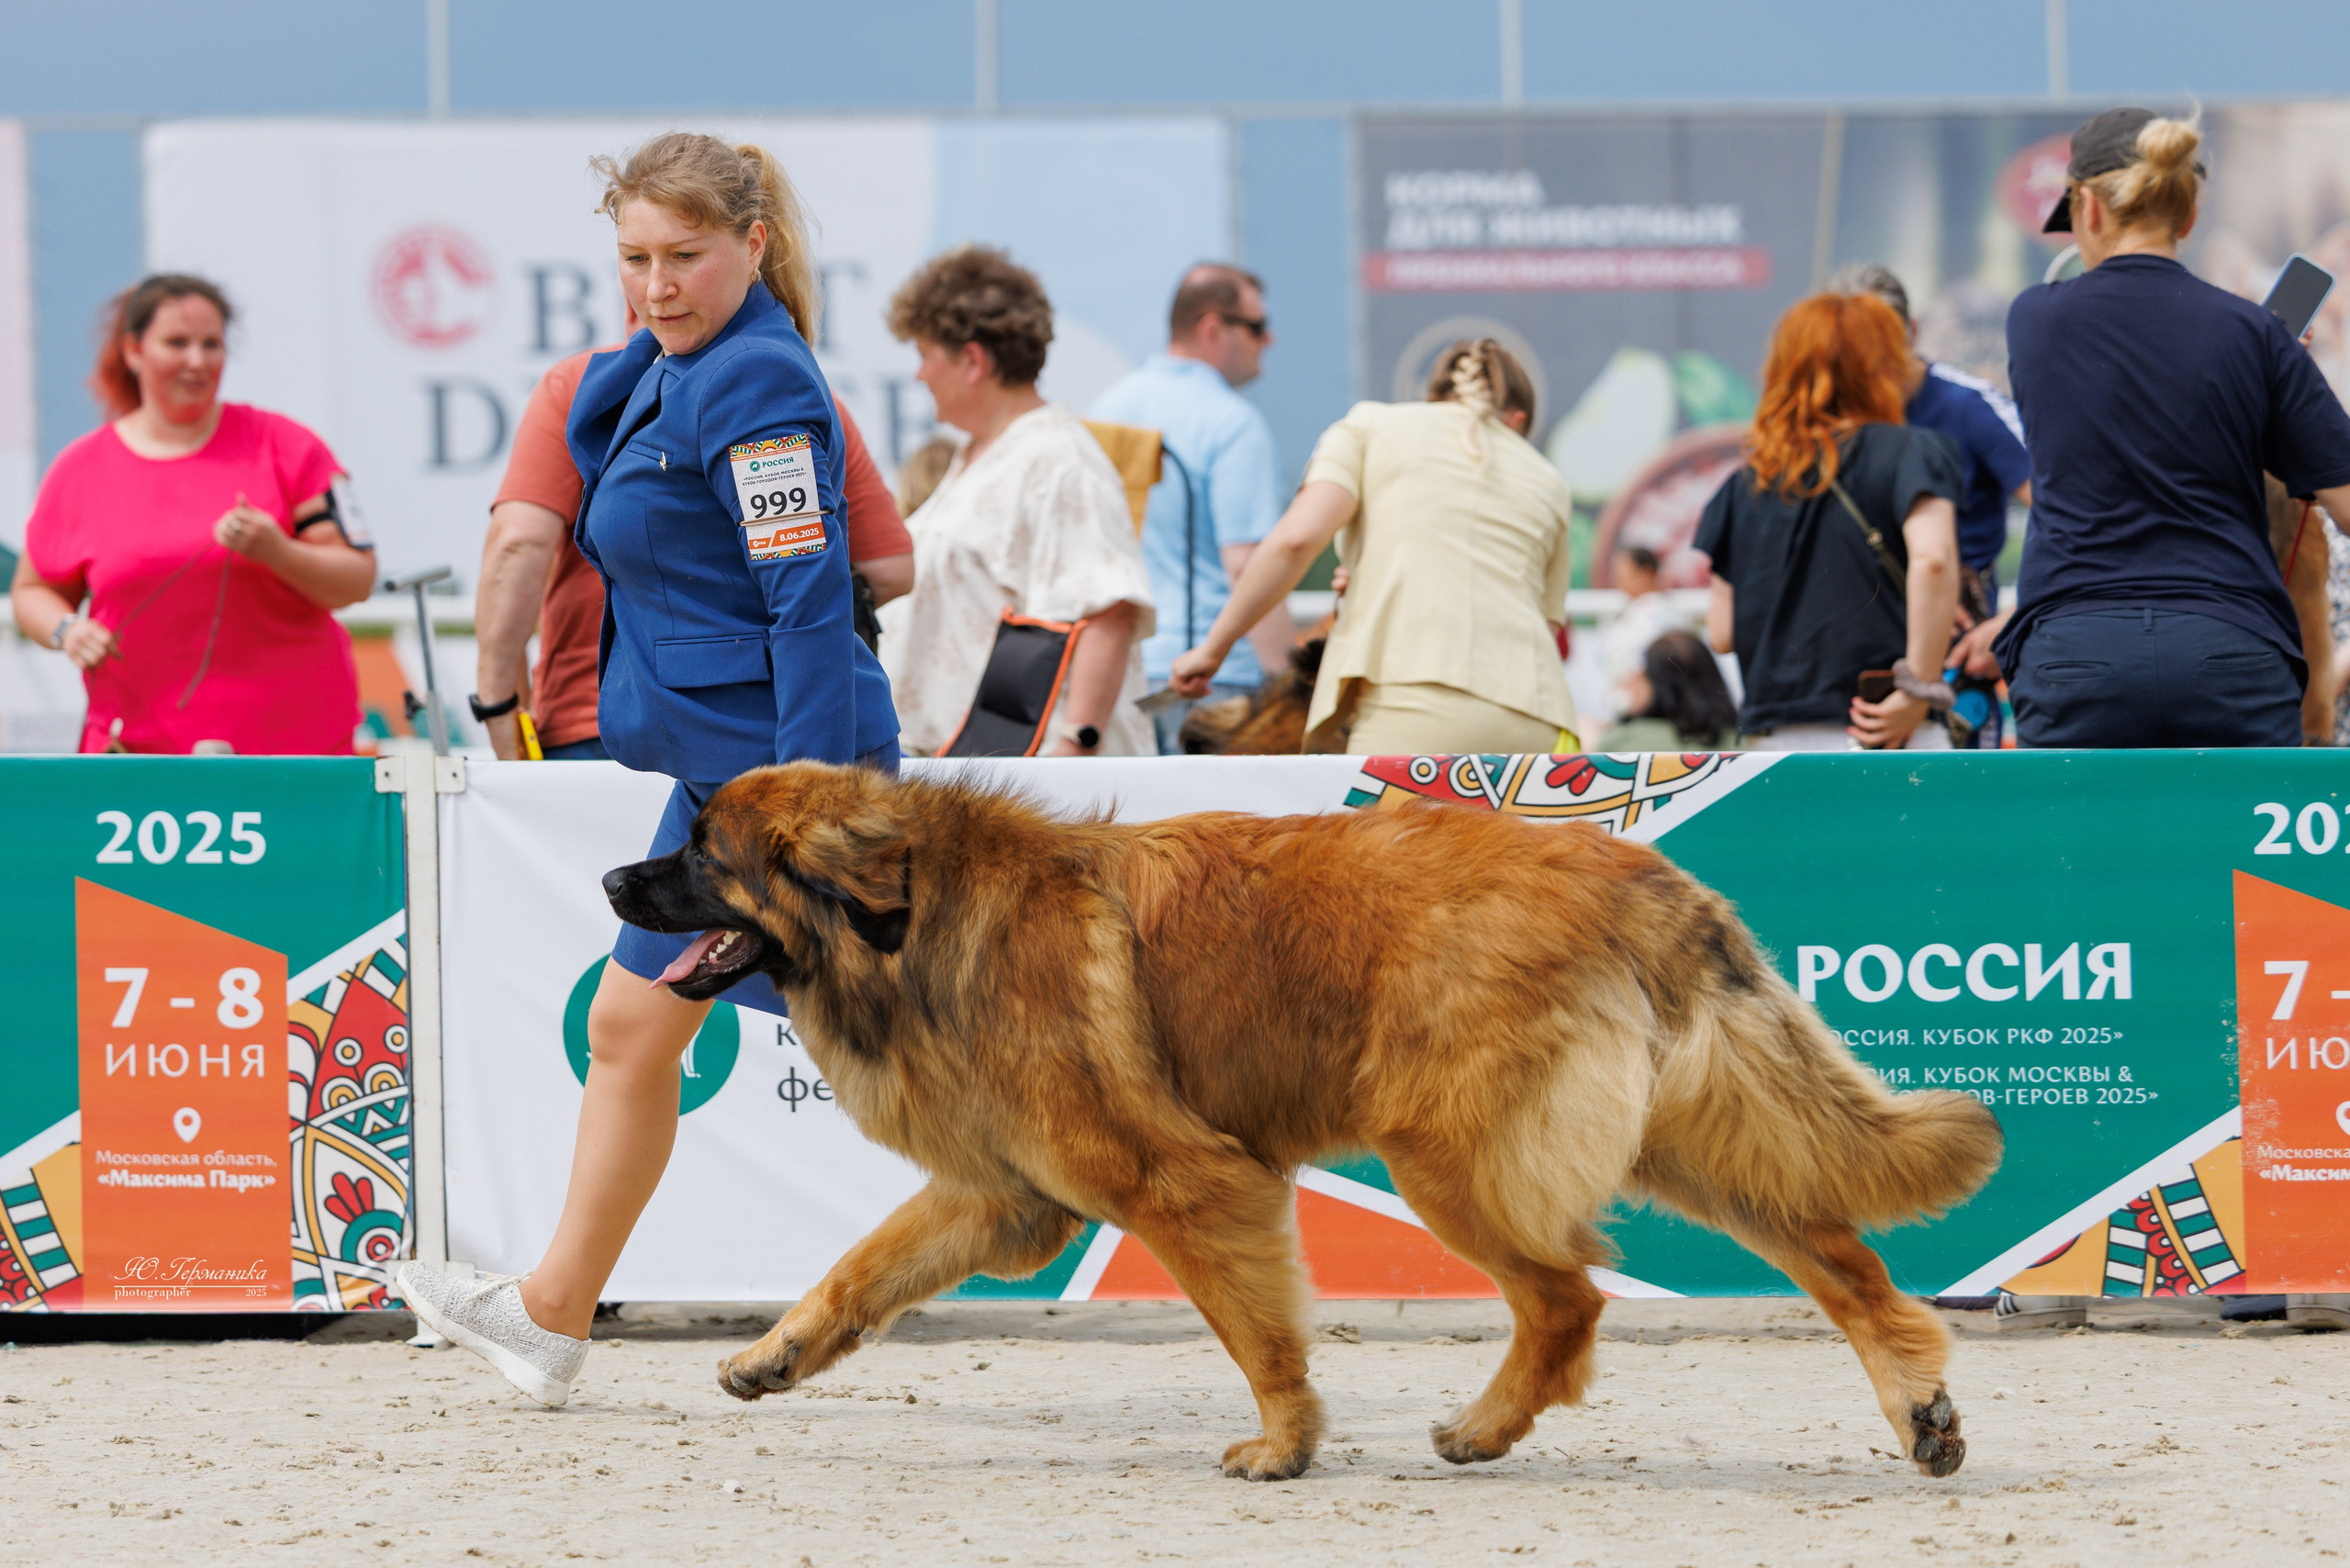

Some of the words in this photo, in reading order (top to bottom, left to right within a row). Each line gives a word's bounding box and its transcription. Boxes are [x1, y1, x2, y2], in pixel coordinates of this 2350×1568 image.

[762, 456, 794, 468] РОССИЯ
[750, 487, 807, 519] 999
[779, 527, 820, 542] 8.06.2025
[95, 810, 266, 865] 2025
[2253, 801, 2350, 856] 20
[1796, 942, 2132, 1003] РОССИЯ
[104, 967, 150, 1028] 7
[217, 967, 264, 1030] 8
[2264, 959, 2310, 1021] 7
[1829, 1029, 1916, 1047] ОССИЯ.
[1923, 1028, 1999, 1046] КУБОК
[2008, 1027, 2053, 1045] РКФ
[2062, 1026, 2123, 1045] 2025»
[106, 1043, 265, 1078] ИЮНЯ
[2266, 1036, 2350, 1070] ИЮ
[1924, 1067, 2000, 1084] КУБОК
[2009, 1066, 2110, 1083] МОСКВЫ
[2118, 1065, 2133, 1082] &
[2097, 1086, 2158, 1104] 2025»
[95, 1149, 200, 1166] Московская
[203, 1149, 277, 1167] область,
[2258, 1145, 2350, 1159] Московска
[97, 1169, 206, 1188] «Максима
[209, 1169, 276, 1193] Парк»
[2259, 1163, 2350, 1182] «Максим
